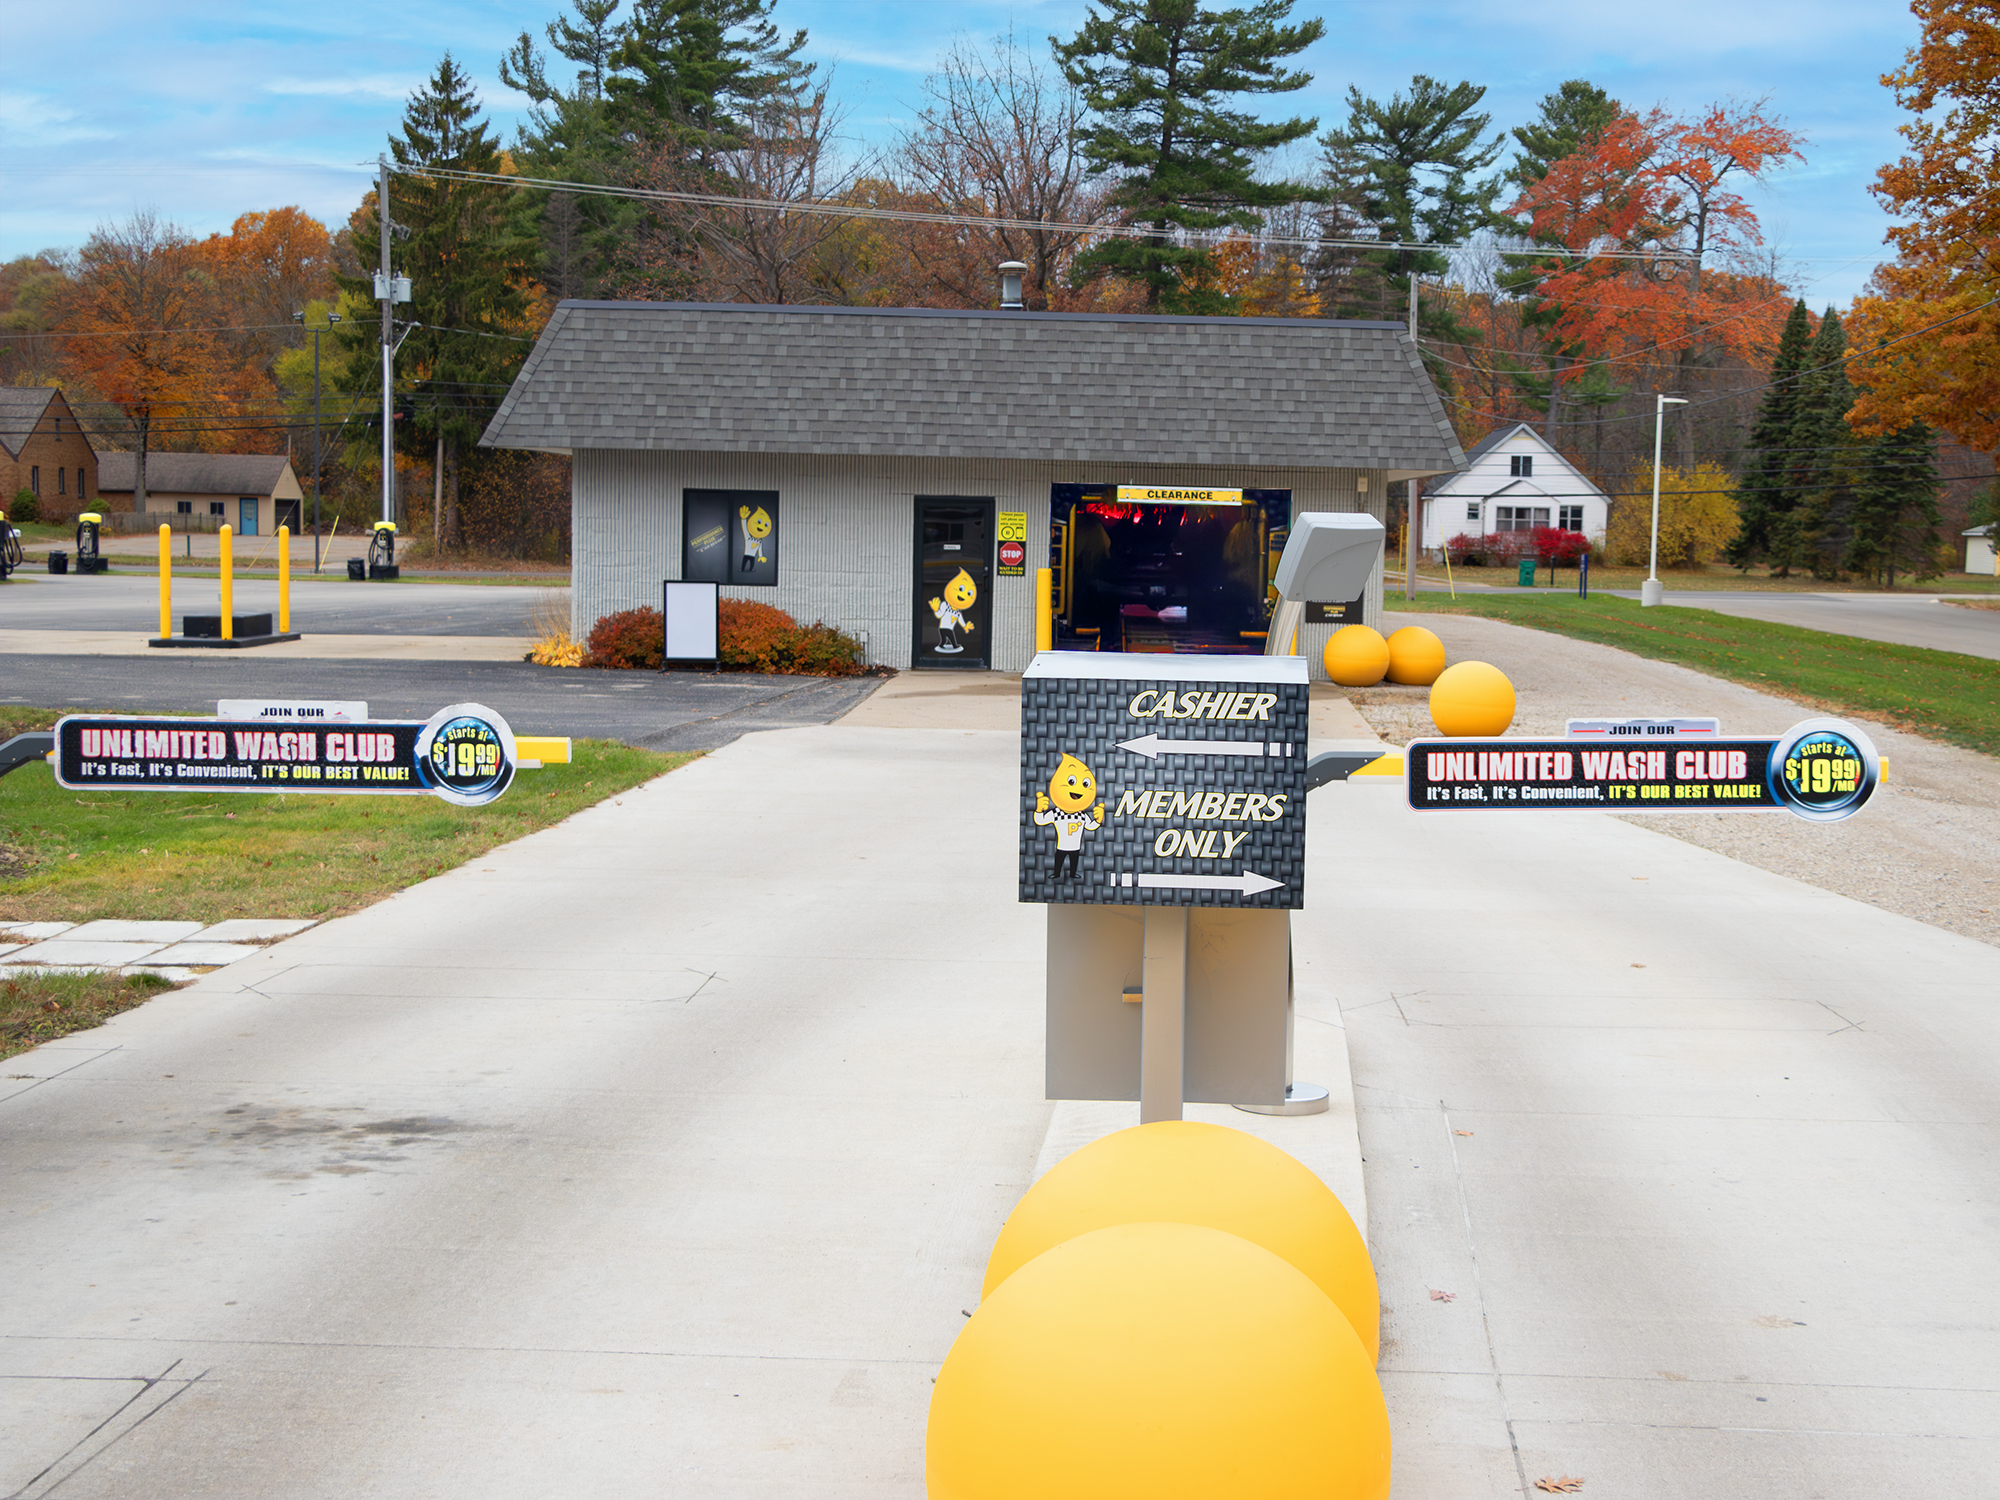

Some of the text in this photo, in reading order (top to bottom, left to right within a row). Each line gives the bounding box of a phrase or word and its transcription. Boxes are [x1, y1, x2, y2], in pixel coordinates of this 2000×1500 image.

[1147, 490, 1213, 500] CLEARANCE
[1002, 550, 1021, 558] STOP
[261, 708, 324, 717] JOIN OUR
[1128, 690, 1278, 721] CASHIER
[447, 726, 489, 741] starts at
[1609, 726, 1675, 735] JOIN OUR
[81, 729, 396, 762] UNLIMITED WASH CLUB
[1801, 741, 1847, 757] starts at
[82, 762, 410, 780] It's Fast, It's Convenient, IT'S OUR BEST VALUE!
[1427, 750, 1747, 781] UNLIMITED WASH CLUB
[1427, 784, 1761, 801] It's Fast, It's Convenient, IT'S OUR BEST VALUE!
[1114, 790, 1287, 821] MEMBERS
[1154, 829, 1248, 858] ONLY
